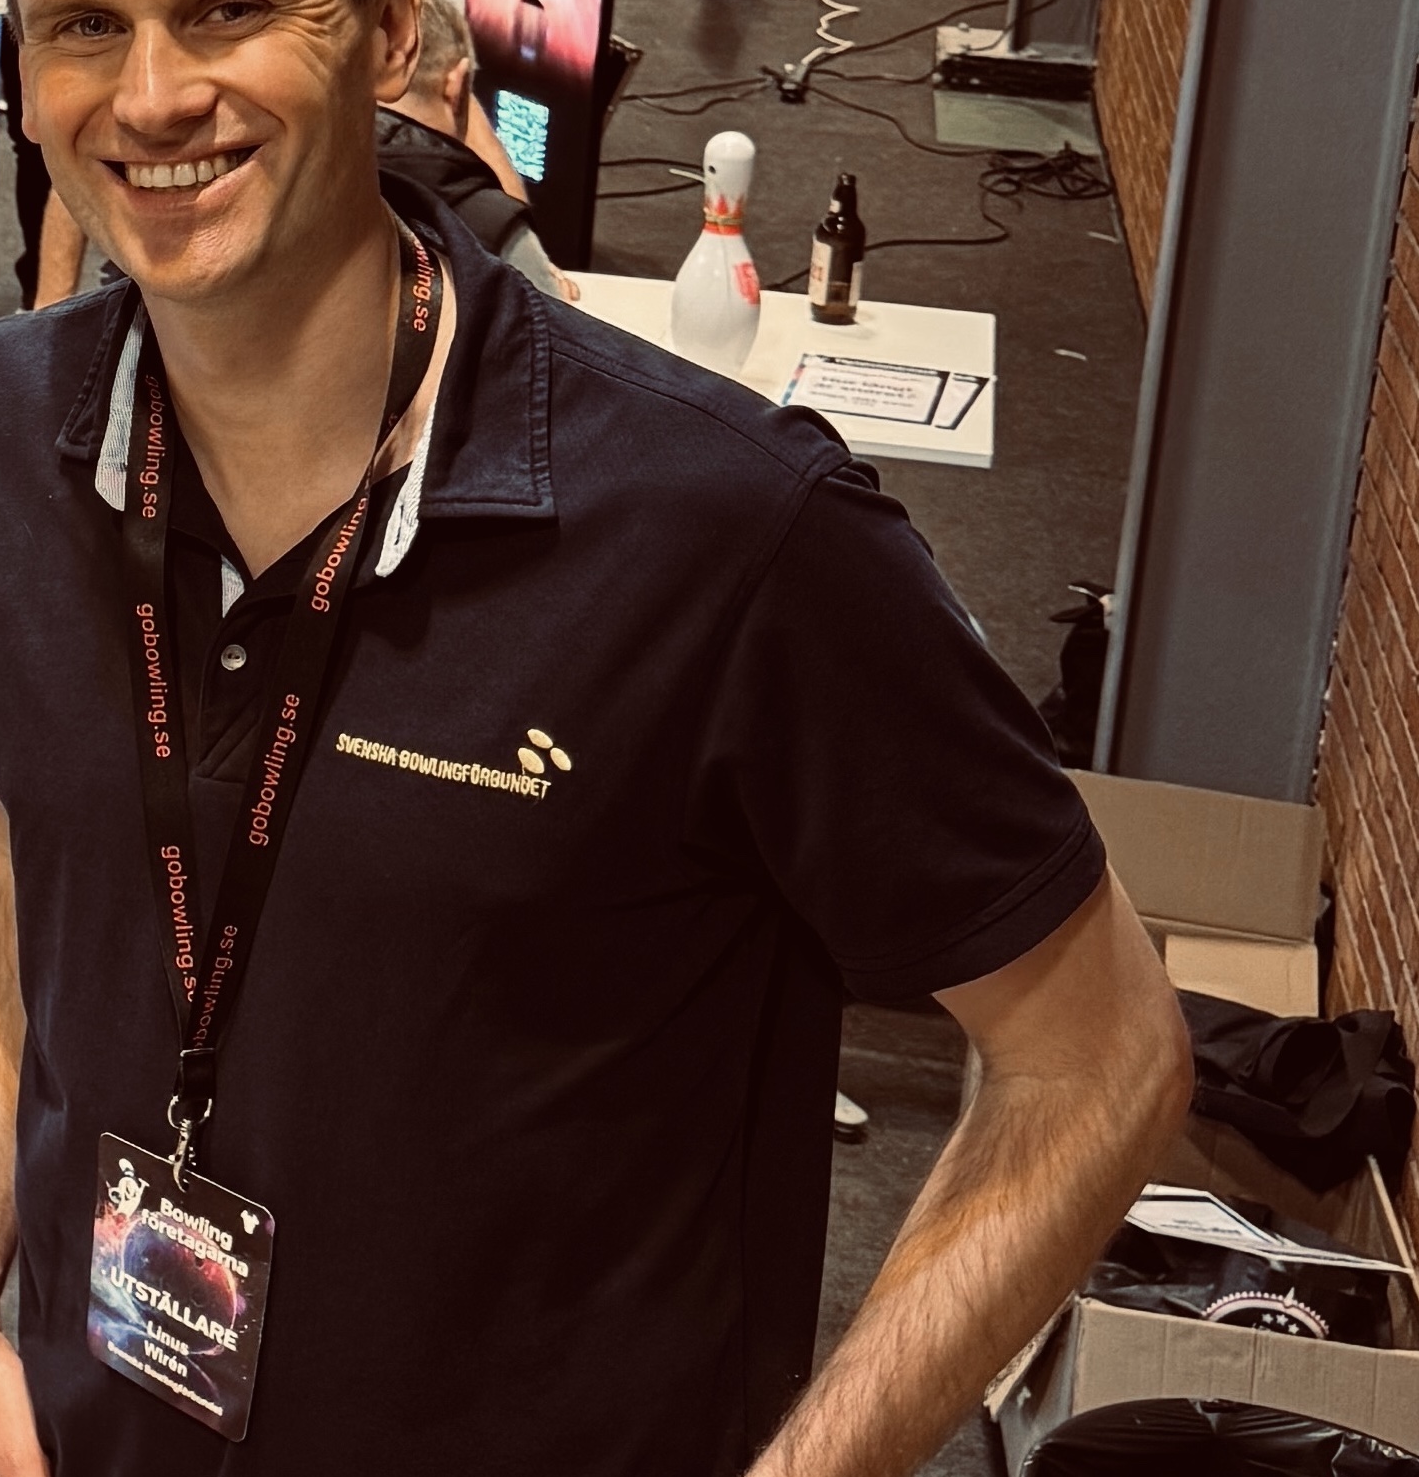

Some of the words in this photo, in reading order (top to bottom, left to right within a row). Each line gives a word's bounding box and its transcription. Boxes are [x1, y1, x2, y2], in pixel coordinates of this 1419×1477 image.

[412, 238, 434, 333] owling.se
[139, 374, 167, 519] gobowling.se
[136, 603, 171, 759] gobowling.se
[248, 693, 301, 847] gobowling.se
[335, 732, 398, 766] SVENSKA
[398, 749, 552, 800] BOWLINGFÖRBUNDET
[194, 924, 238, 1049] bowling.se
[141, 1208, 249, 1278] företagarna
[160, 1197, 234, 1251] Bowling
[110, 1265, 239, 1352] UTSTÄLLARE
[146, 1319, 190, 1356] Linus
